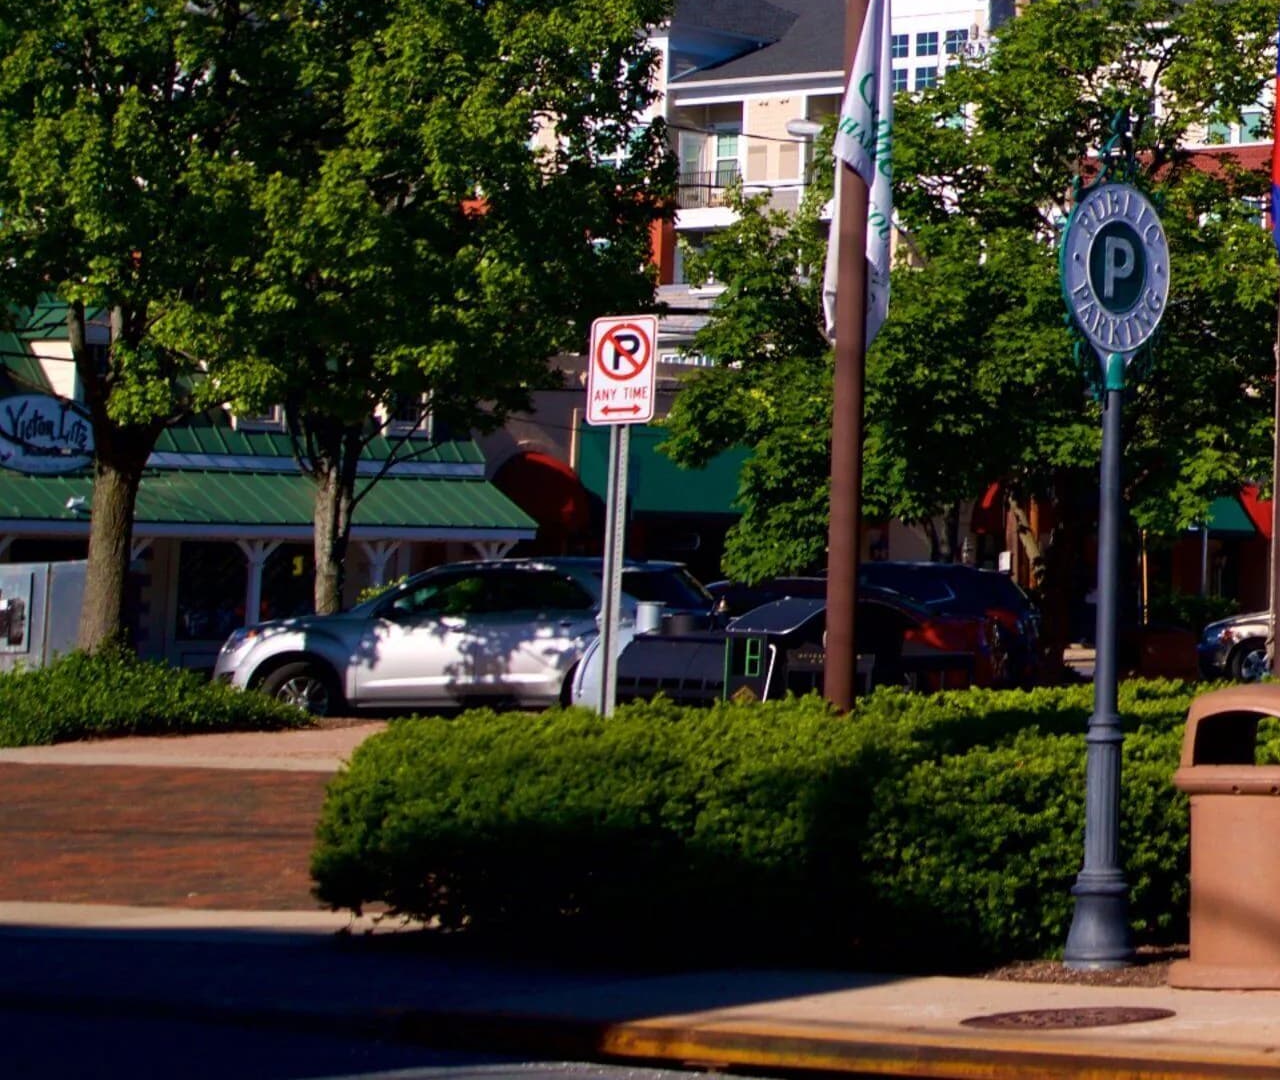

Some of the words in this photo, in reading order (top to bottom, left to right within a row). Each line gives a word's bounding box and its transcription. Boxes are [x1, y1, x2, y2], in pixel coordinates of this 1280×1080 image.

[1075, 190, 1160, 246] PUBLIC
[1104, 236, 1135, 299] P
[1073, 280, 1160, 345] PARKING
[595, 388, 616, 401] ANY
[624, 386, 648, 400] TIME
